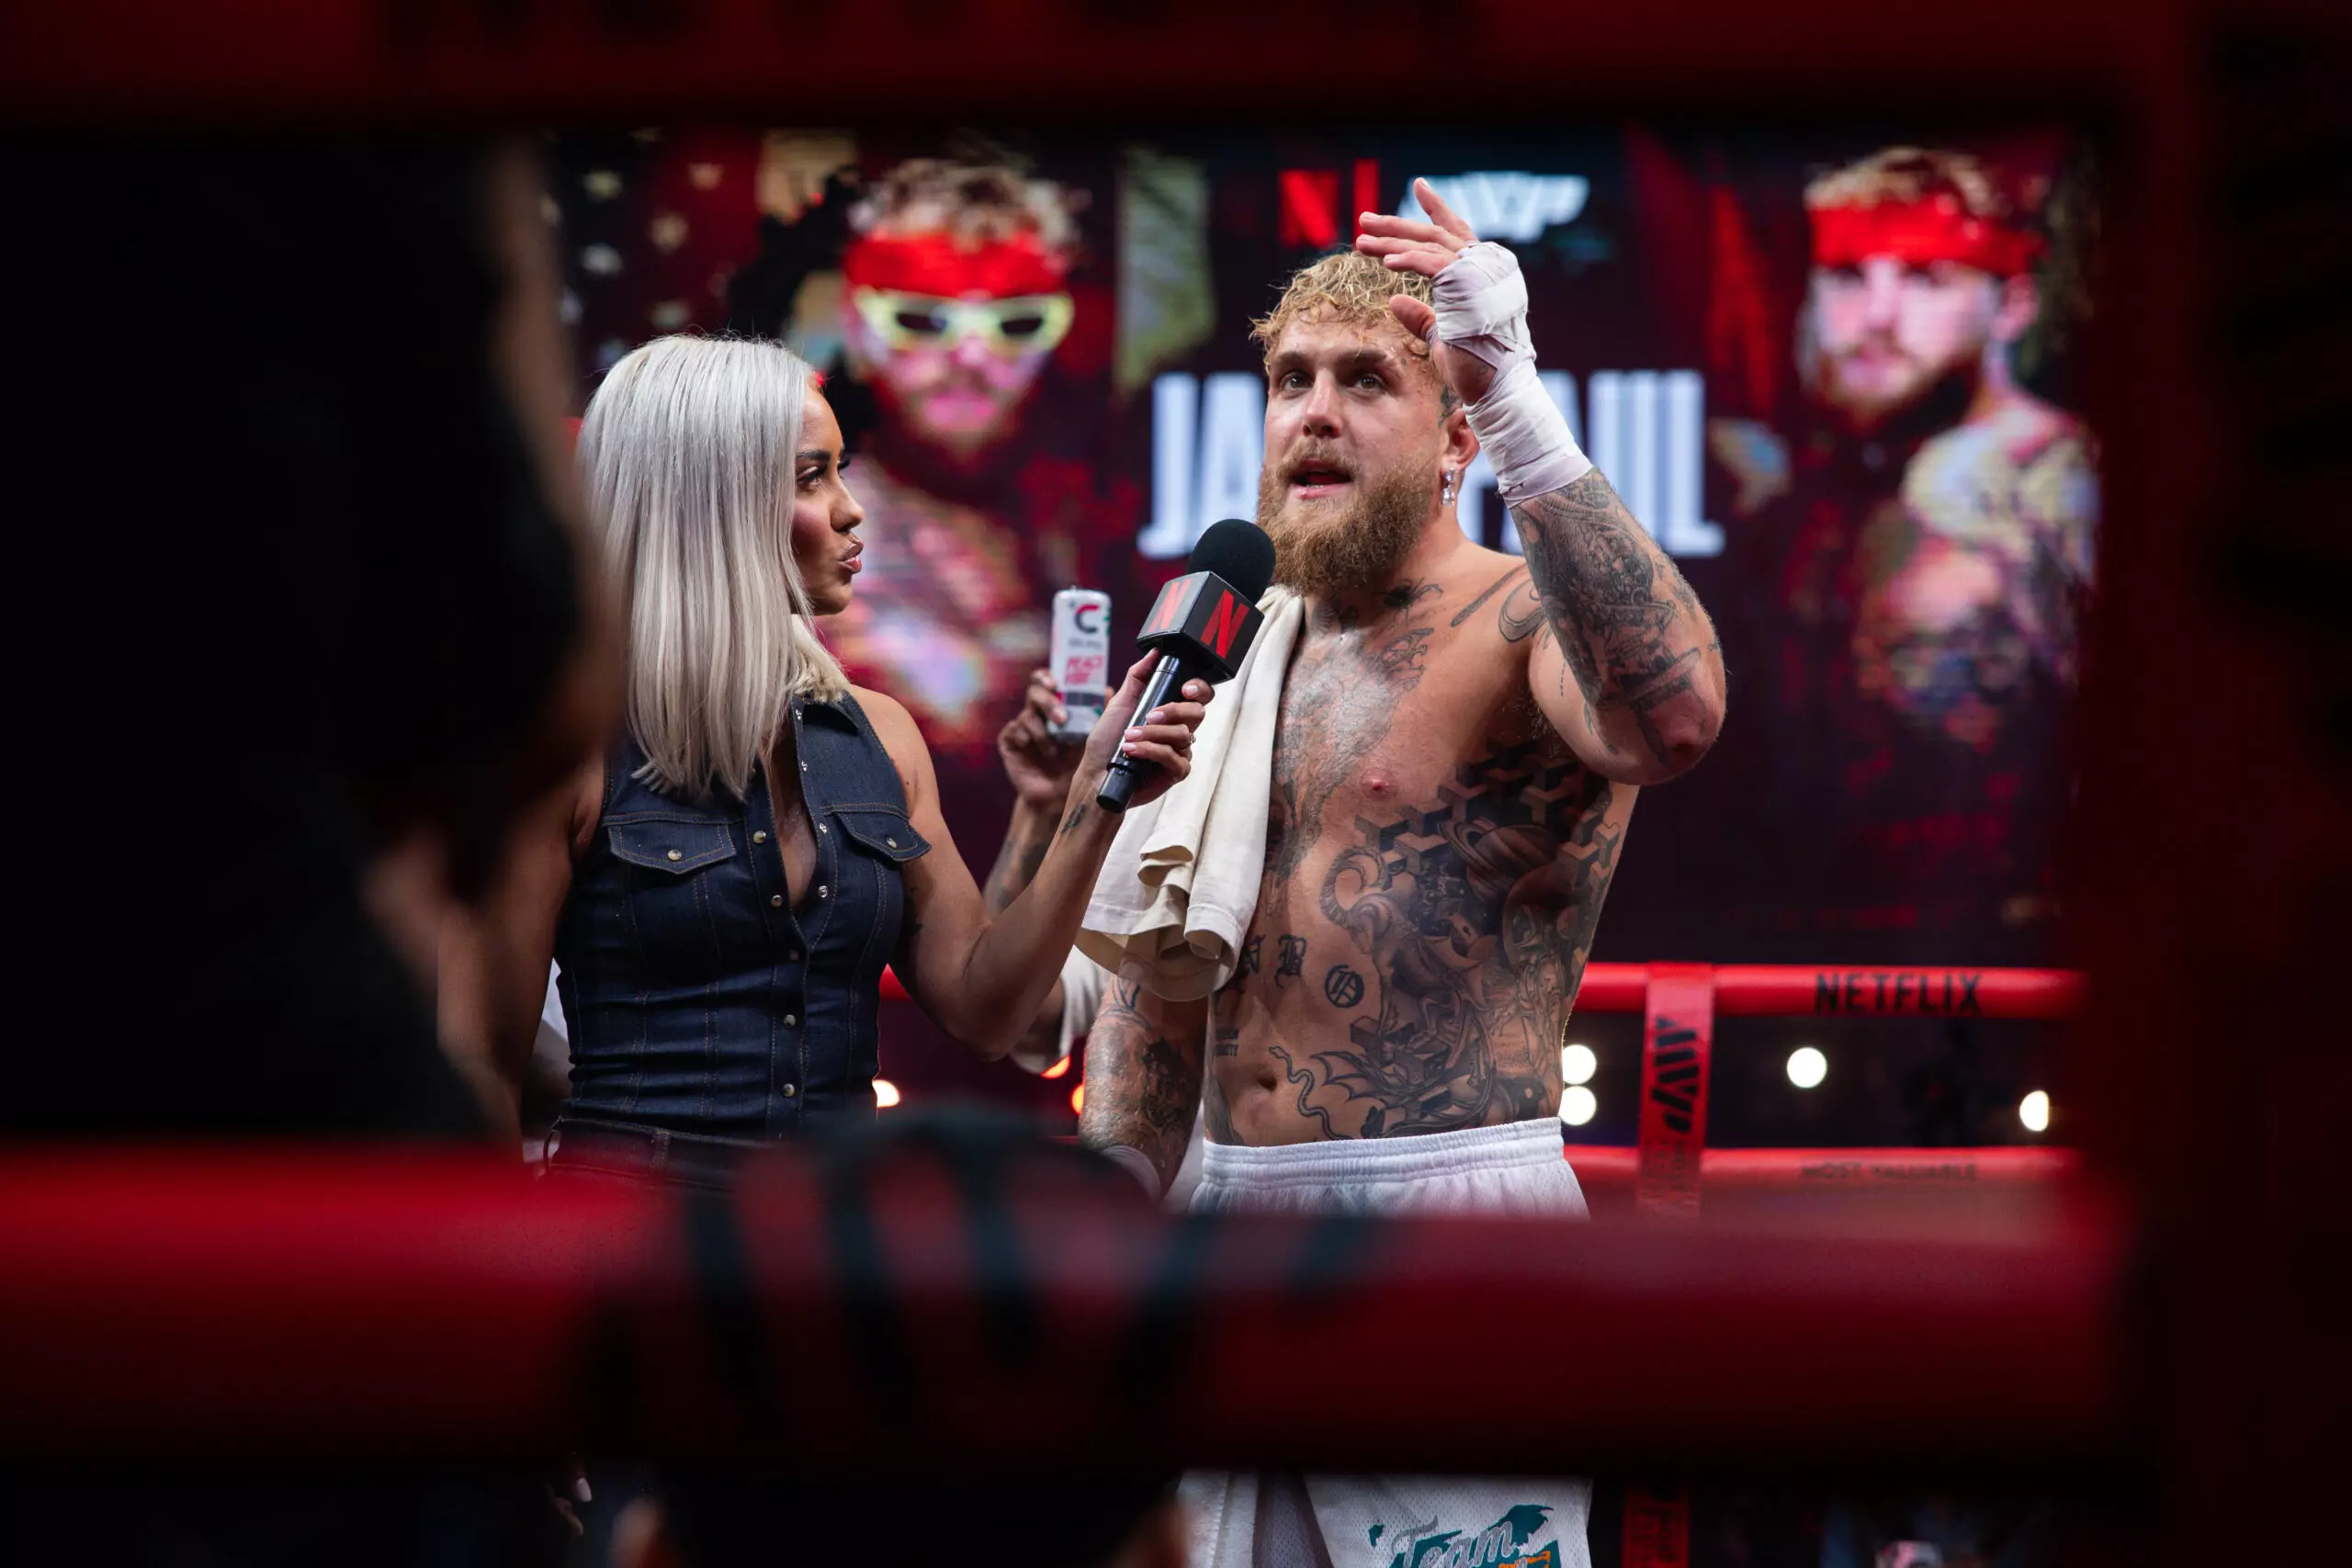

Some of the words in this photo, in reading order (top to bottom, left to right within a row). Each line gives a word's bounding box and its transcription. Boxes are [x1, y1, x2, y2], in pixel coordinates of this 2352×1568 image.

[1148, 578, 1192, 633] N
[1200, 589, 1250, 660] N
[1815, 973, 1983, 1012] NETFLIX
[1391, 1516, 1519, 1568] Team
